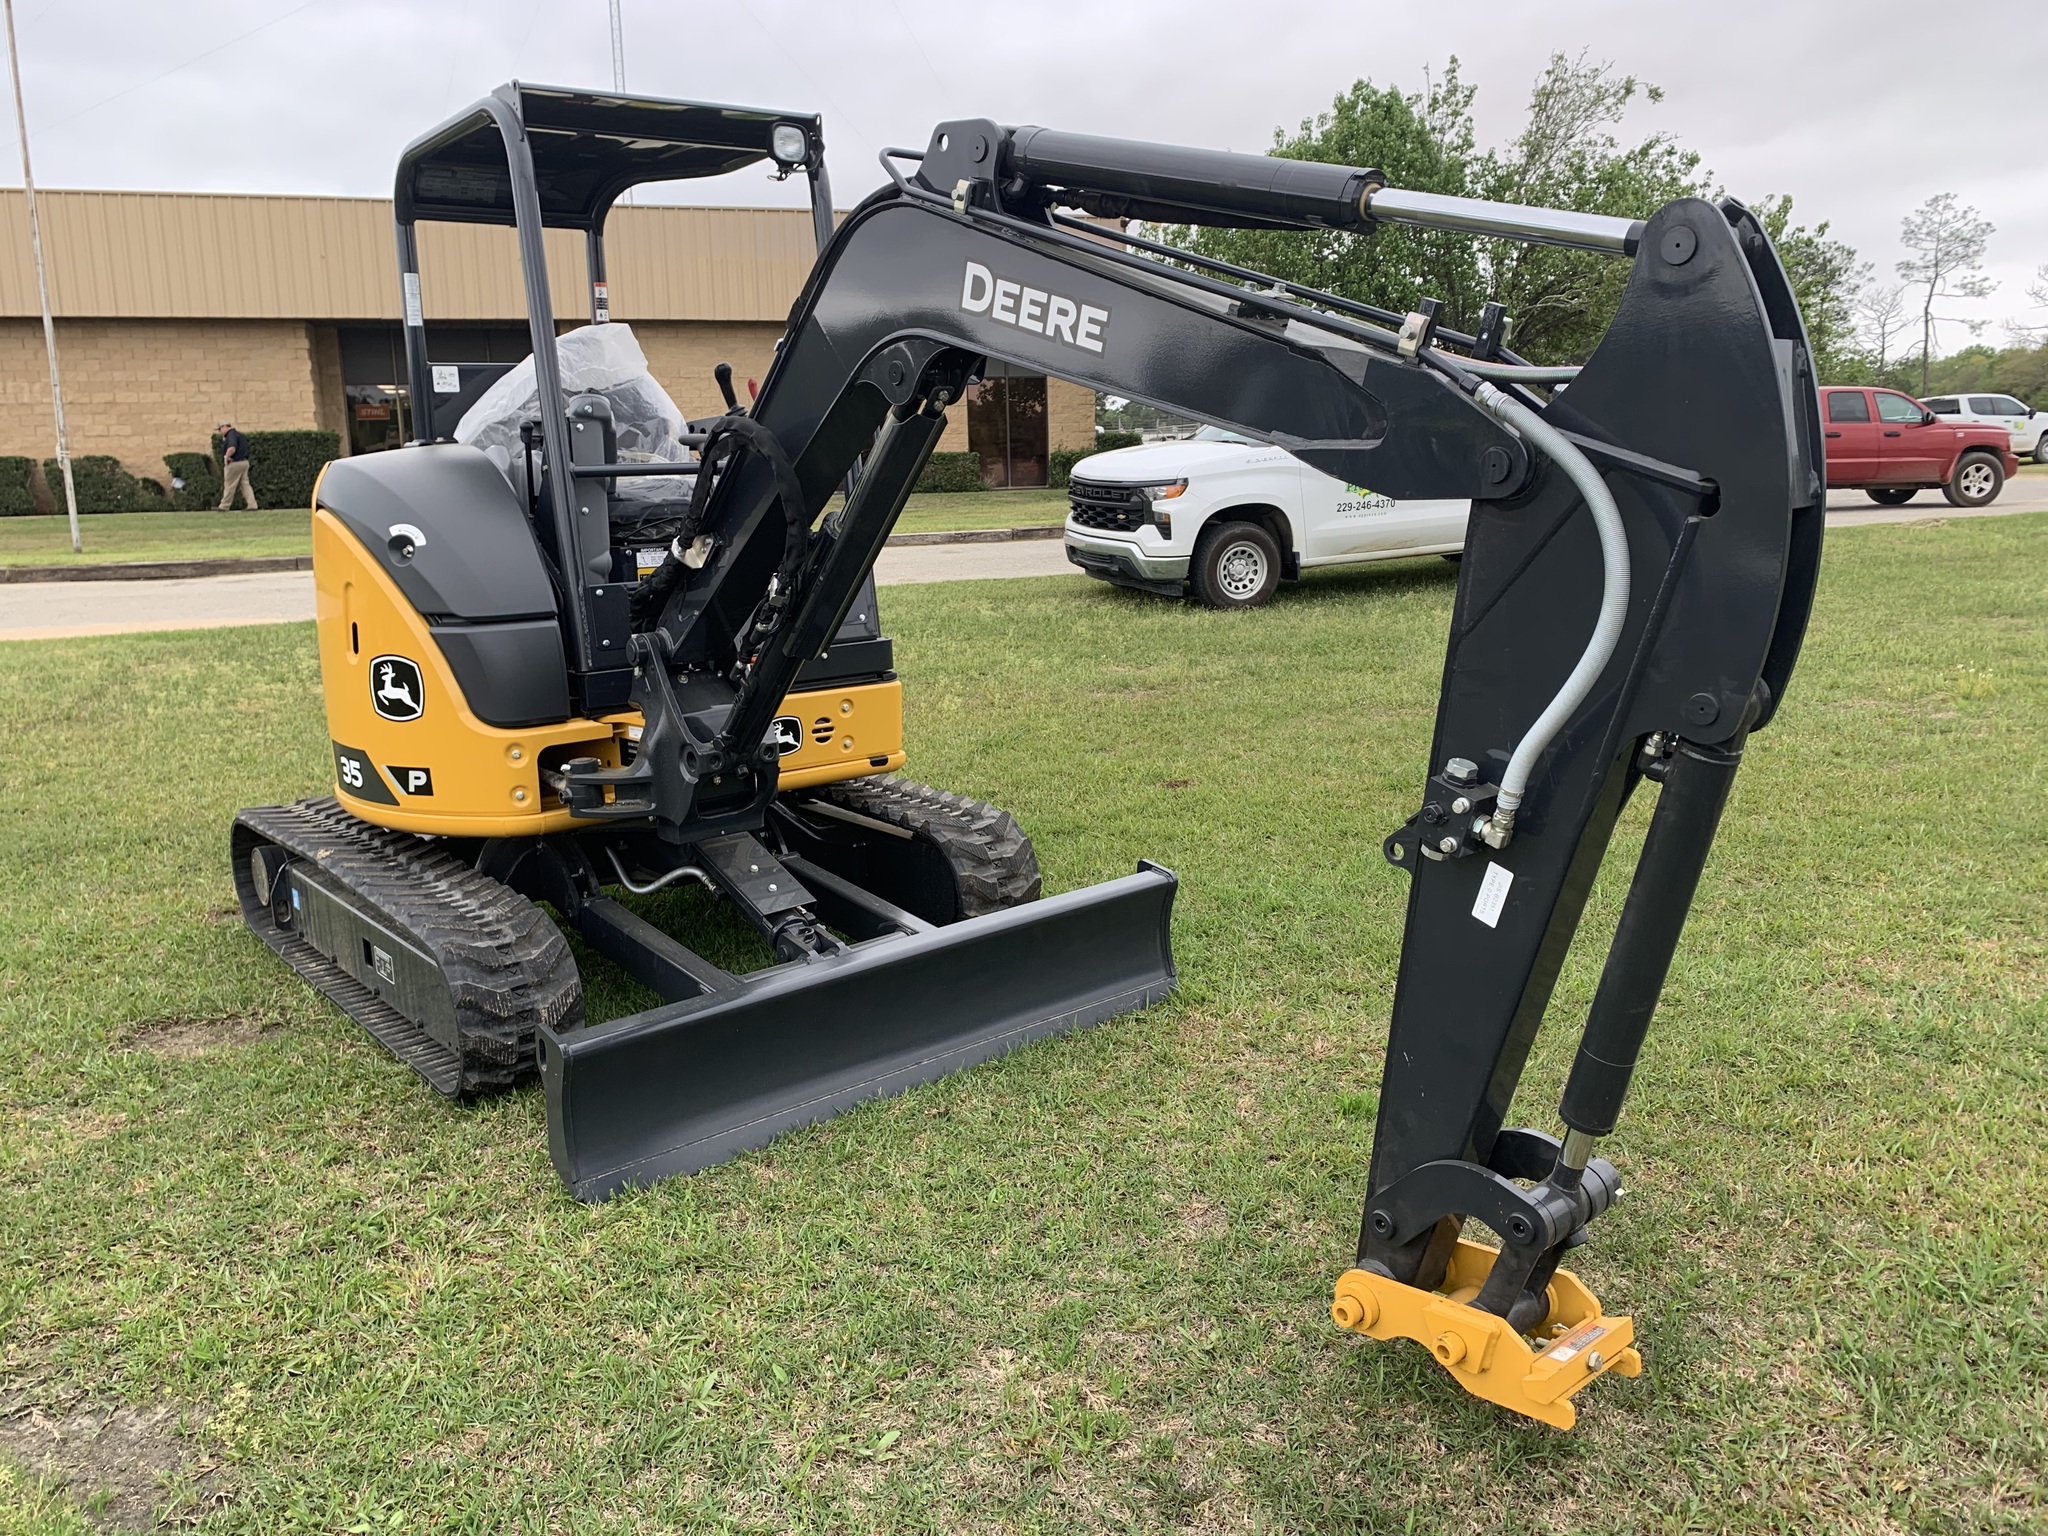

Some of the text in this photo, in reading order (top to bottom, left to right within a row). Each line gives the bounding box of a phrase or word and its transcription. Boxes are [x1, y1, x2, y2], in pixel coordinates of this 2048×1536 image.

[961, 261, 1109, 353] DEERE
[1336, 499, 1396, 513] 229-246-4370
[340, 755, 428, 792] 35 P
[1489, 871, 1499, 887] TYPE
[1480, 893, 1490, 915] PORTS
